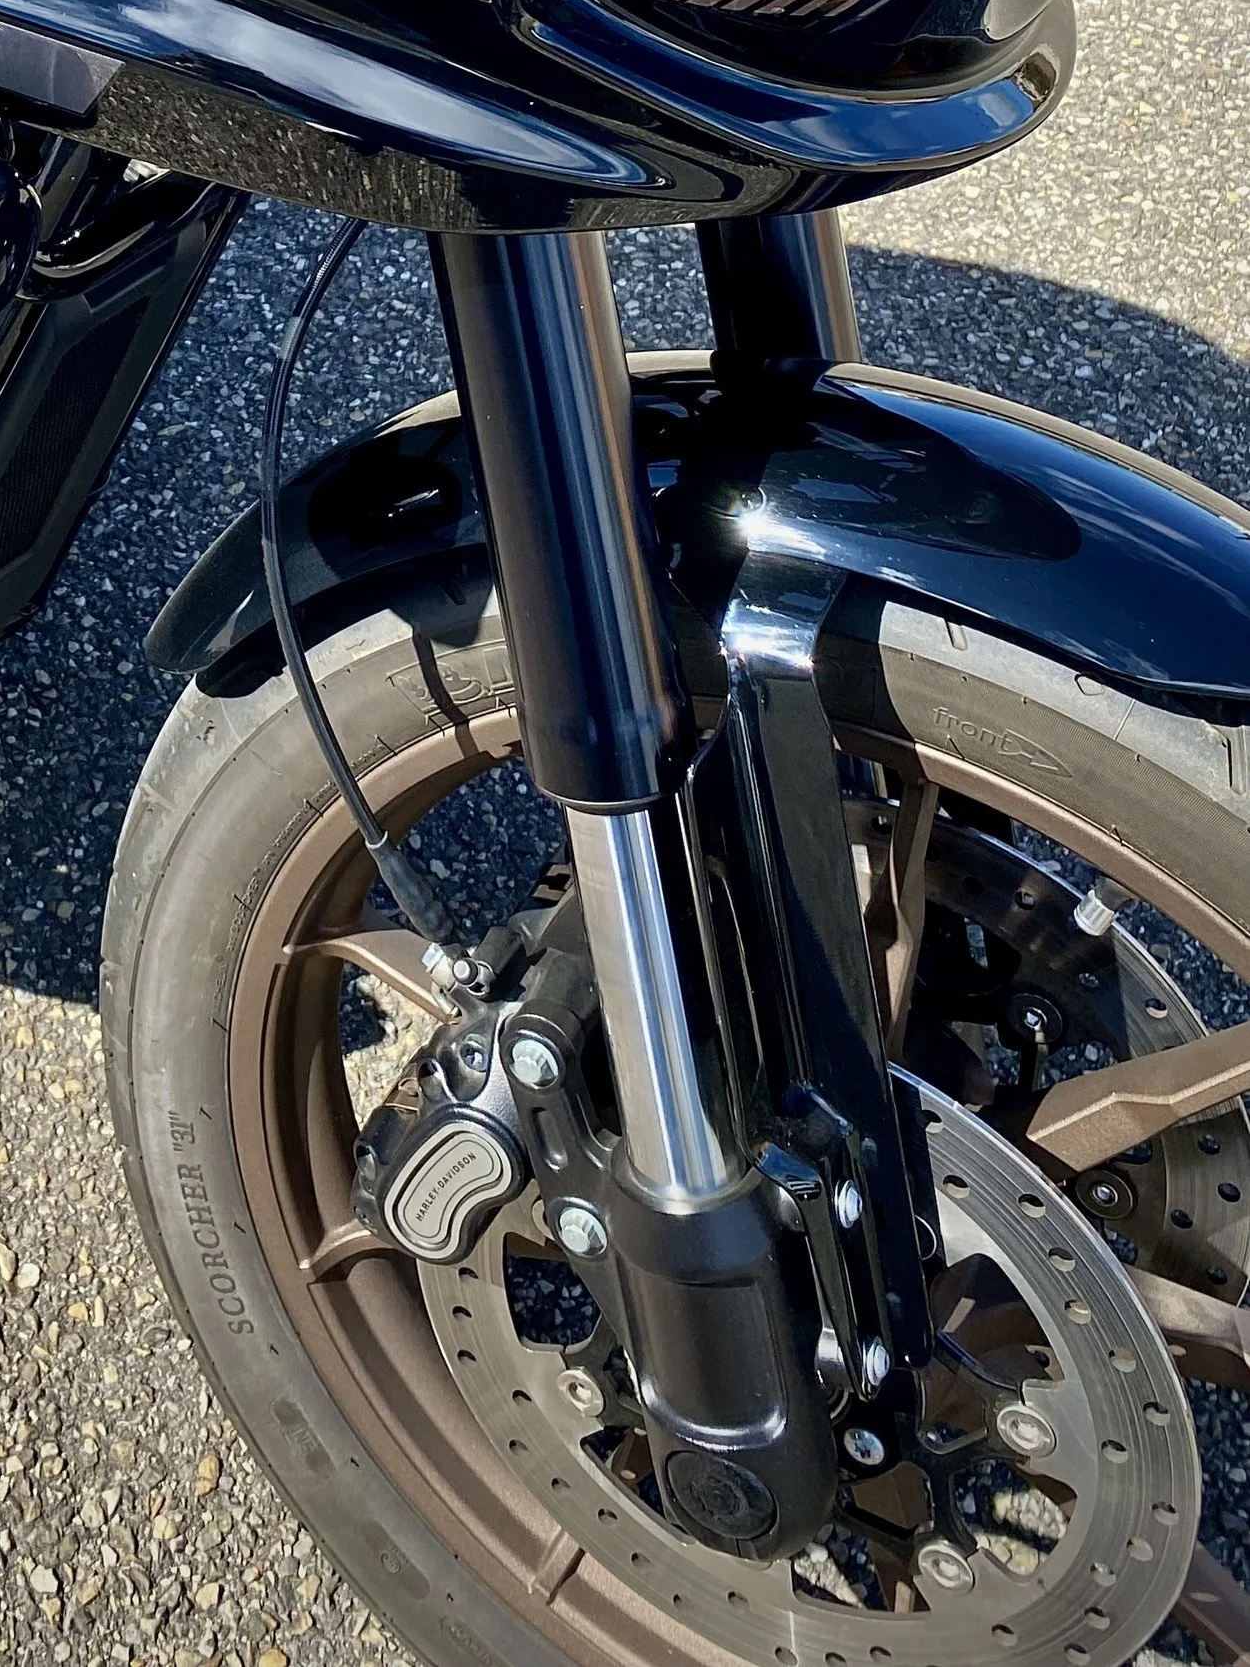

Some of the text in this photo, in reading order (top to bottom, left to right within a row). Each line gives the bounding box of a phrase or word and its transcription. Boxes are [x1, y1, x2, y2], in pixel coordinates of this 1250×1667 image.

[933, 706, 1012, 751] front
[415, 1152, 477, 1222] HARLEY-DAVIDSON
[178, 1163, 254, 1335] SCORCHER
